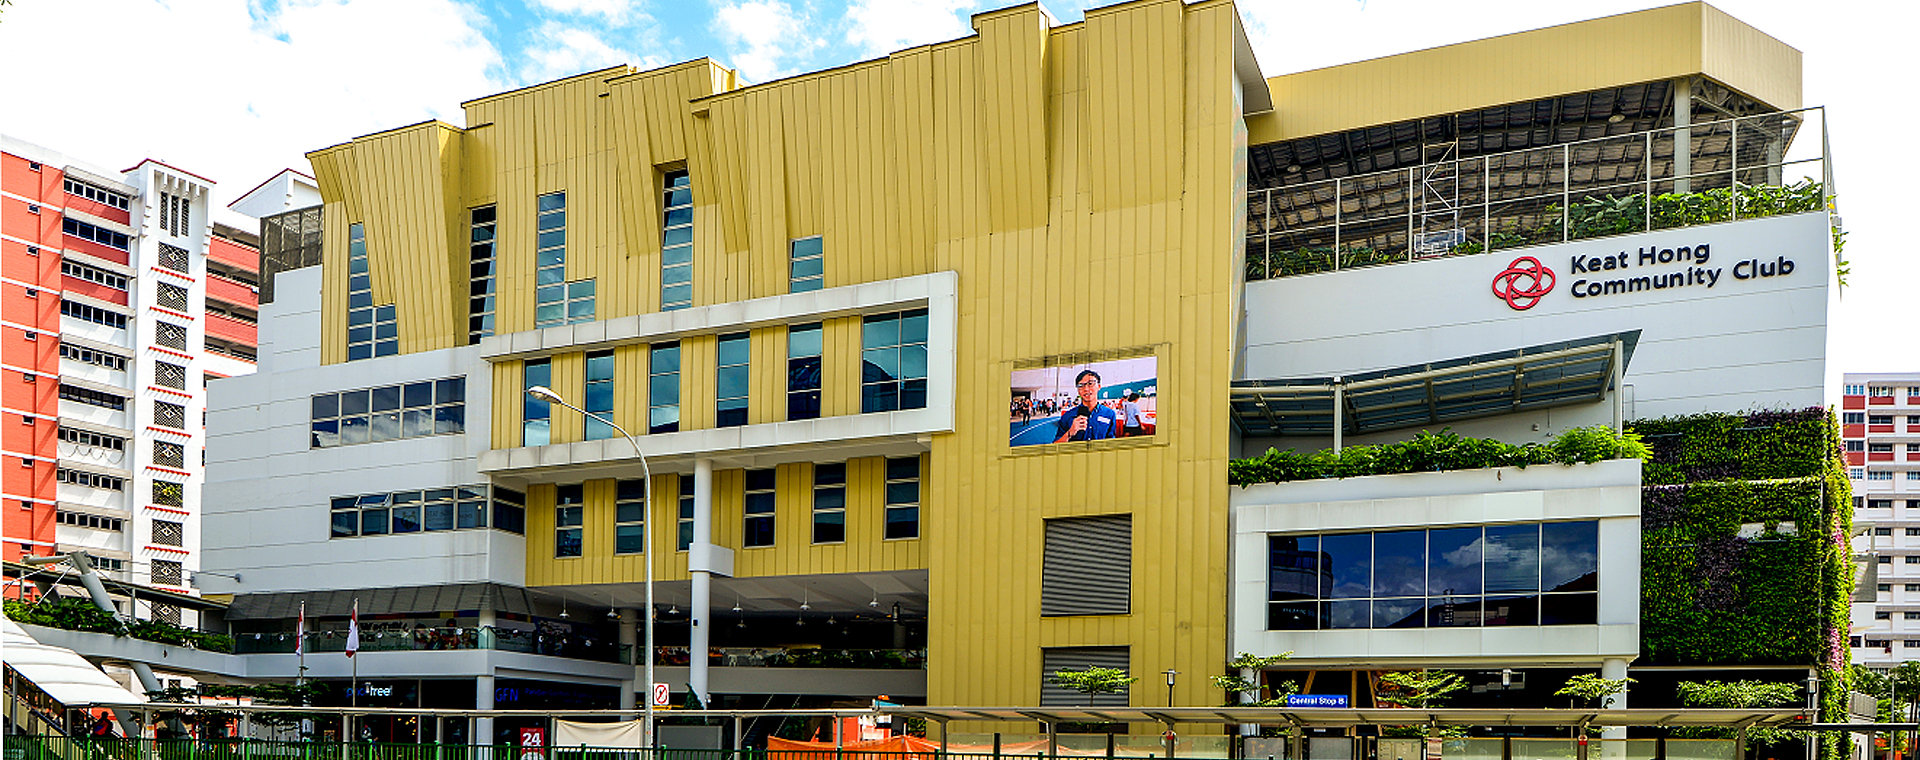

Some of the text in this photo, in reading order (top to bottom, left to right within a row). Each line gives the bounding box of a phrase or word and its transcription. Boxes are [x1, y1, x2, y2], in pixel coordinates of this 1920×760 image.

[1570, 243, 1710, 275] Keat Hong
[1570, 255, 1796, 298] Community Club
[1290, 696, 1345, 706] Central Stop B
[522, 732, 542, 746] 24
